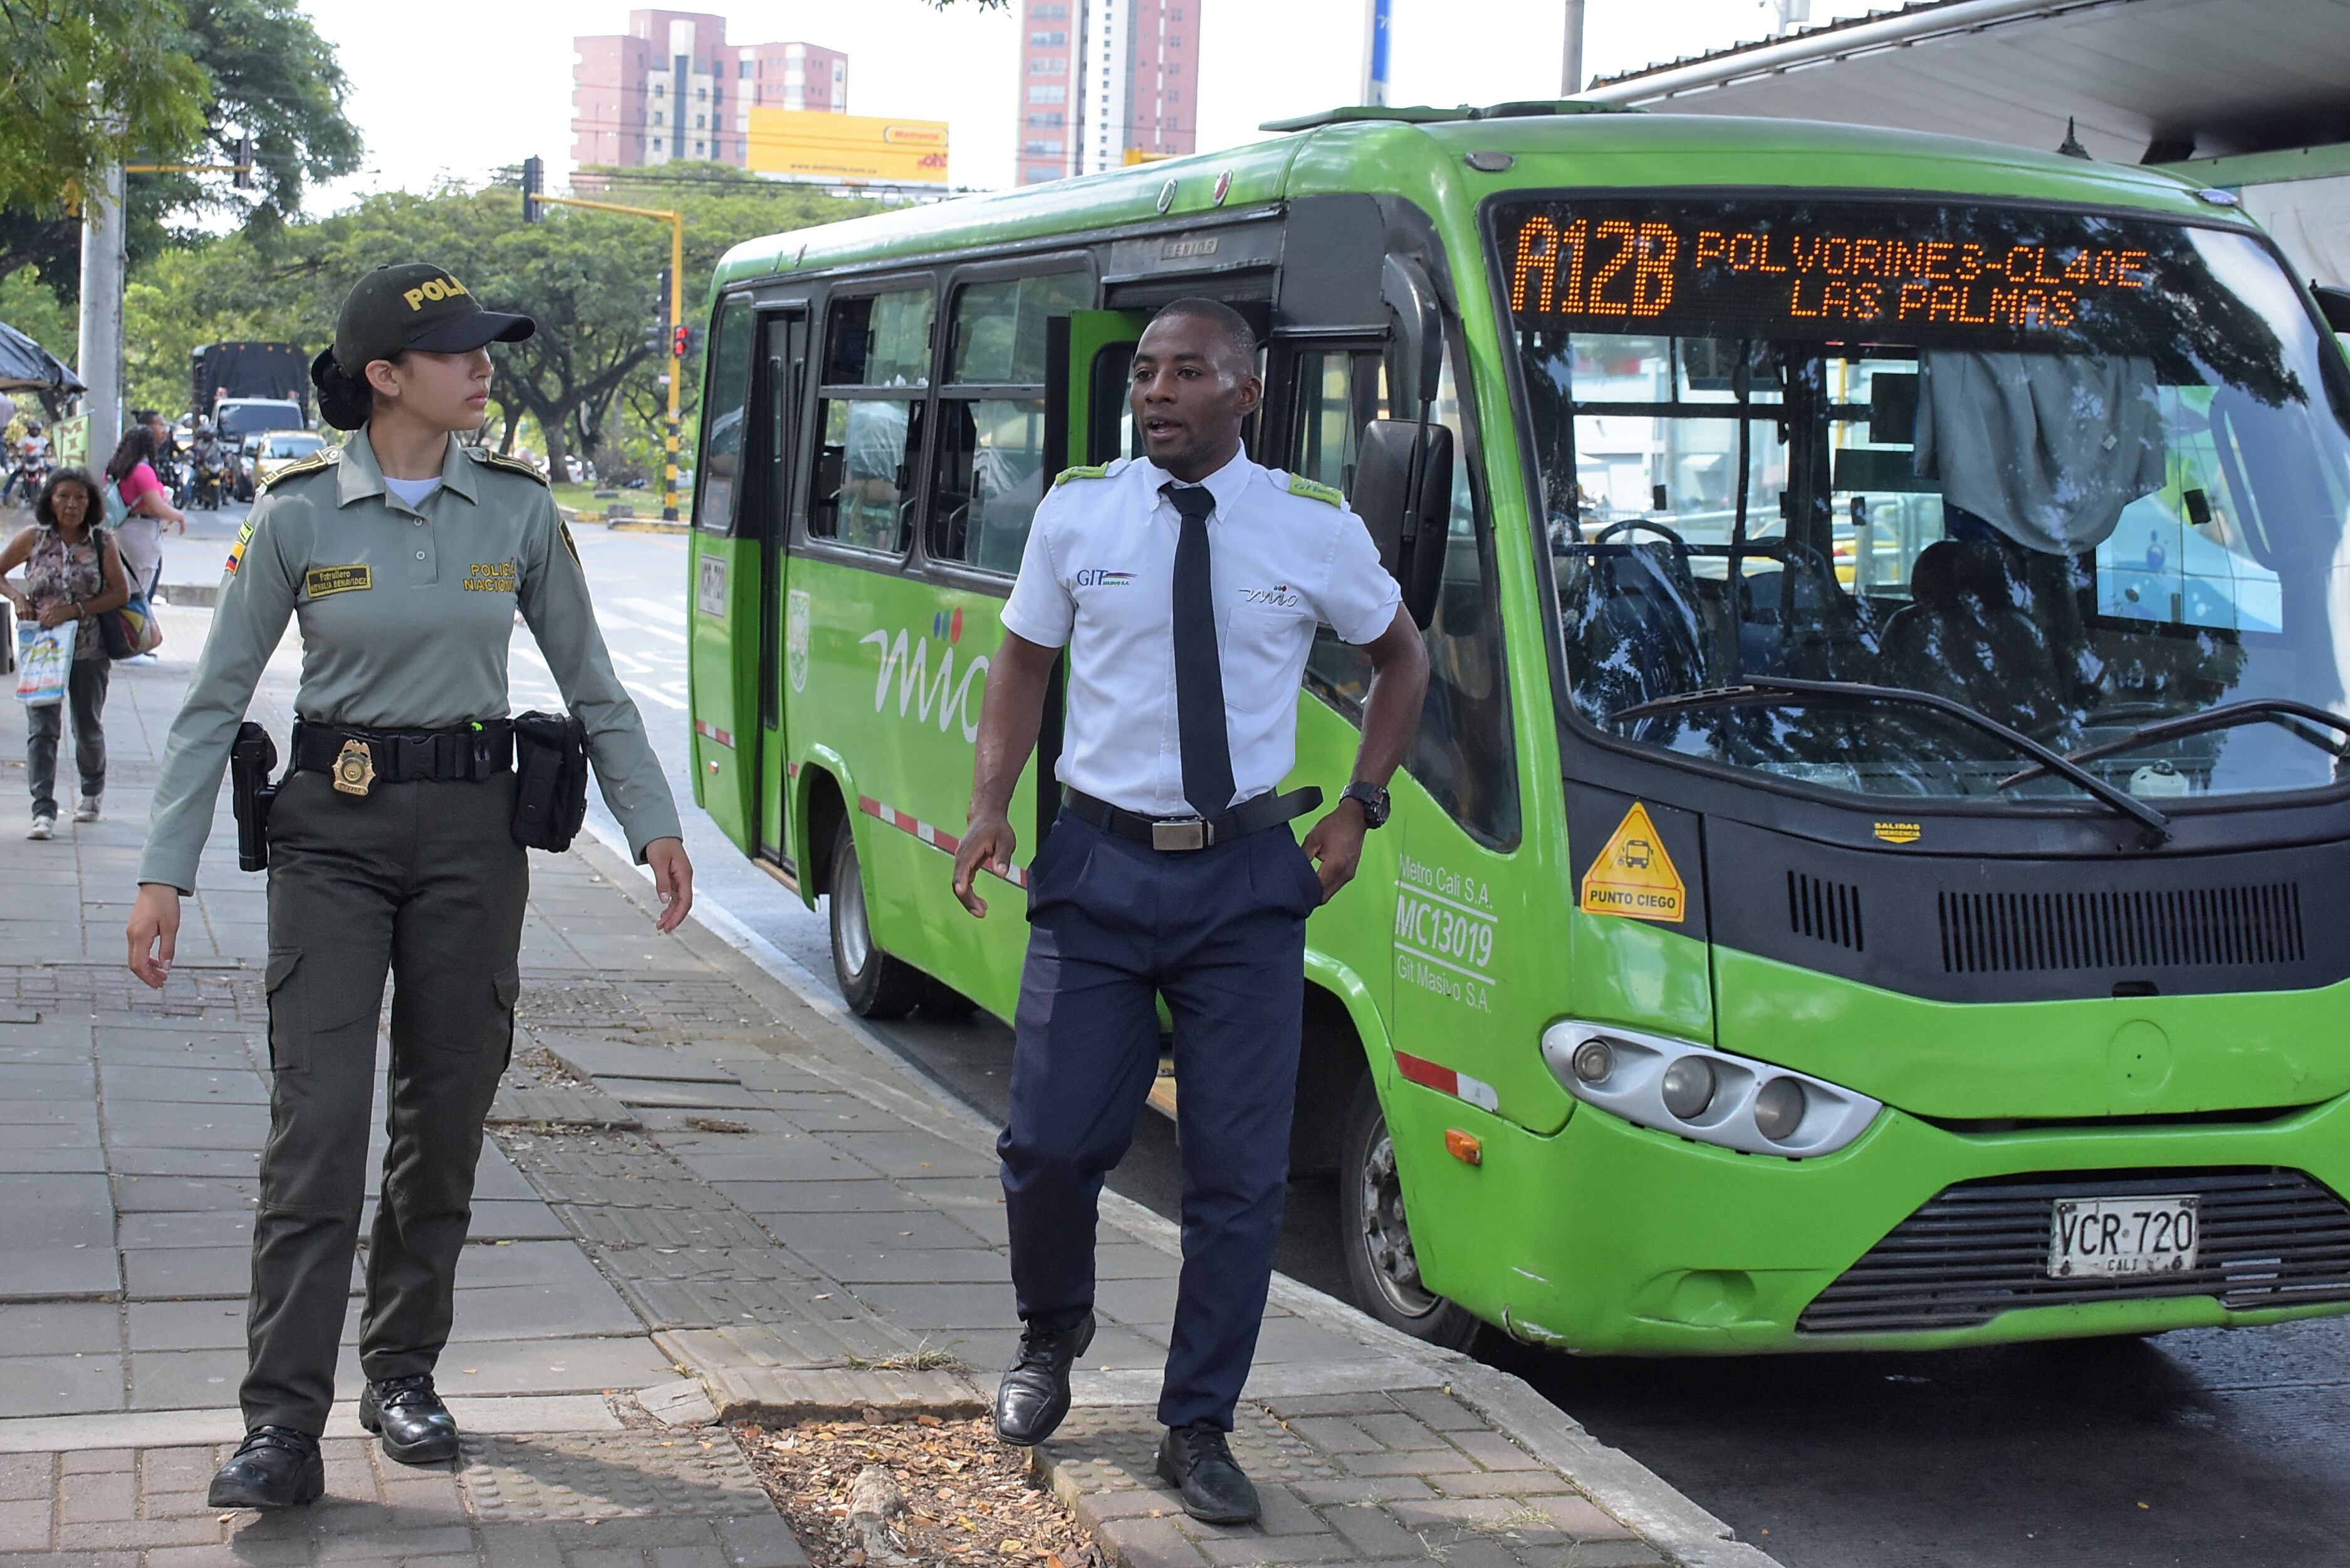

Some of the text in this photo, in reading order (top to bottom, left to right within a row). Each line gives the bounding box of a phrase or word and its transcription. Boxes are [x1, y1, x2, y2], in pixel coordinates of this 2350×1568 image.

[1512, 216, 1678, 316] A12B
[1790, 279, 2077, 327] LAS PALMAS
[320, 571, 350, 581] Patrullero
[1077, 569, 1108, 587] GIT
[1874, 822, 1920, 830] SALIDAS
[1399, 853, 1493, 909] Metro Cali S.A.
[1590, 890, 1676, 909] PUNTO CIEGO
[1395, 895, 1493, 967] MC13019
[1397, 954, 1414, 983] Git
[1418, 962, 1461, 1001] Masivo
[2107, 1258, 2138, 1271] CALI
